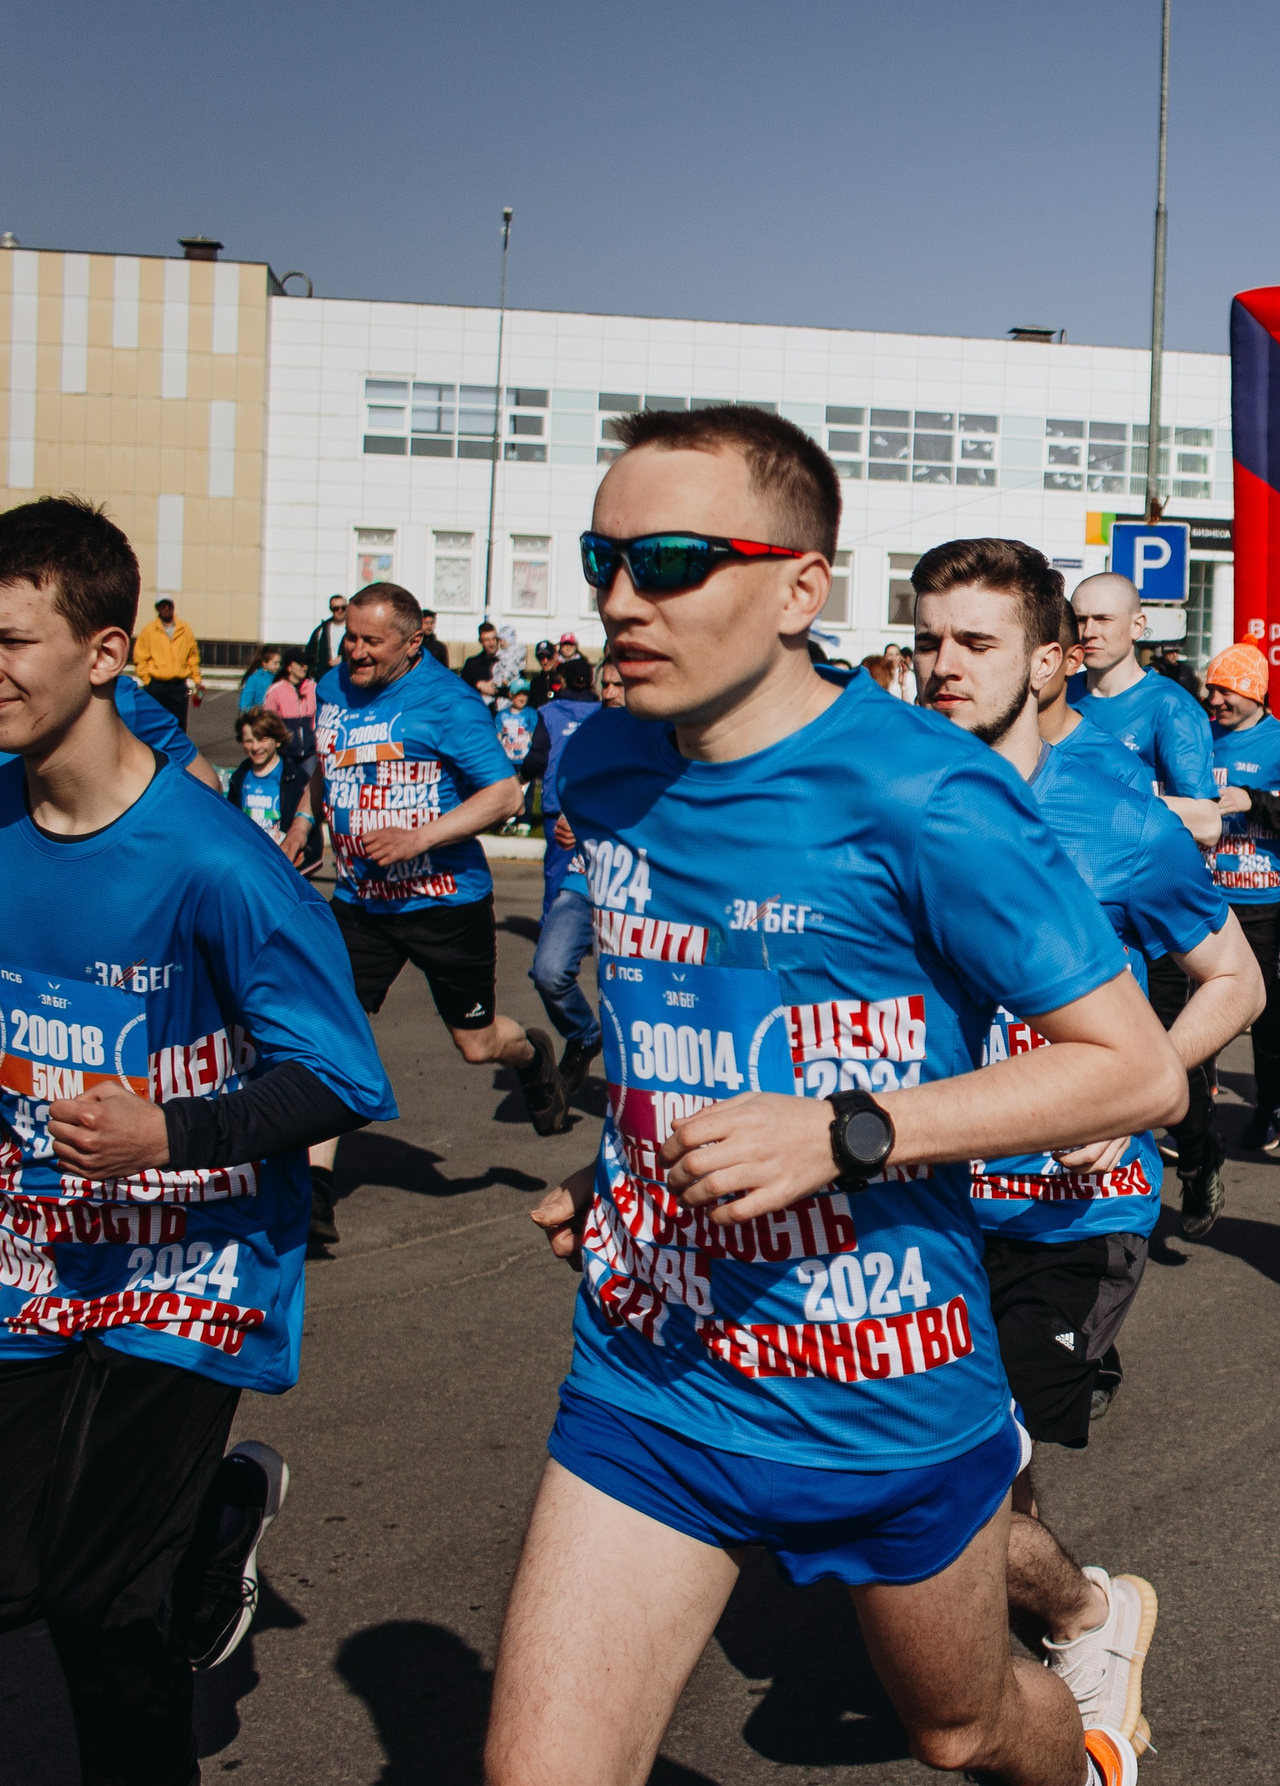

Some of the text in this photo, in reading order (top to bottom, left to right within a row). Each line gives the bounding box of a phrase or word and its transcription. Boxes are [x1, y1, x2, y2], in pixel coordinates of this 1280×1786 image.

[1249, 618, 1265, 639] В
[347, 721, 389, 747] 20008
[618, 966, 644, 982] ПСБ
[11, 1008, 105, 1067] 20018
[631, 1019, 745, 1091] 30014
[124, 1239, 240, 1301] 2024
[799, 1246, 932, 1322] 2024
